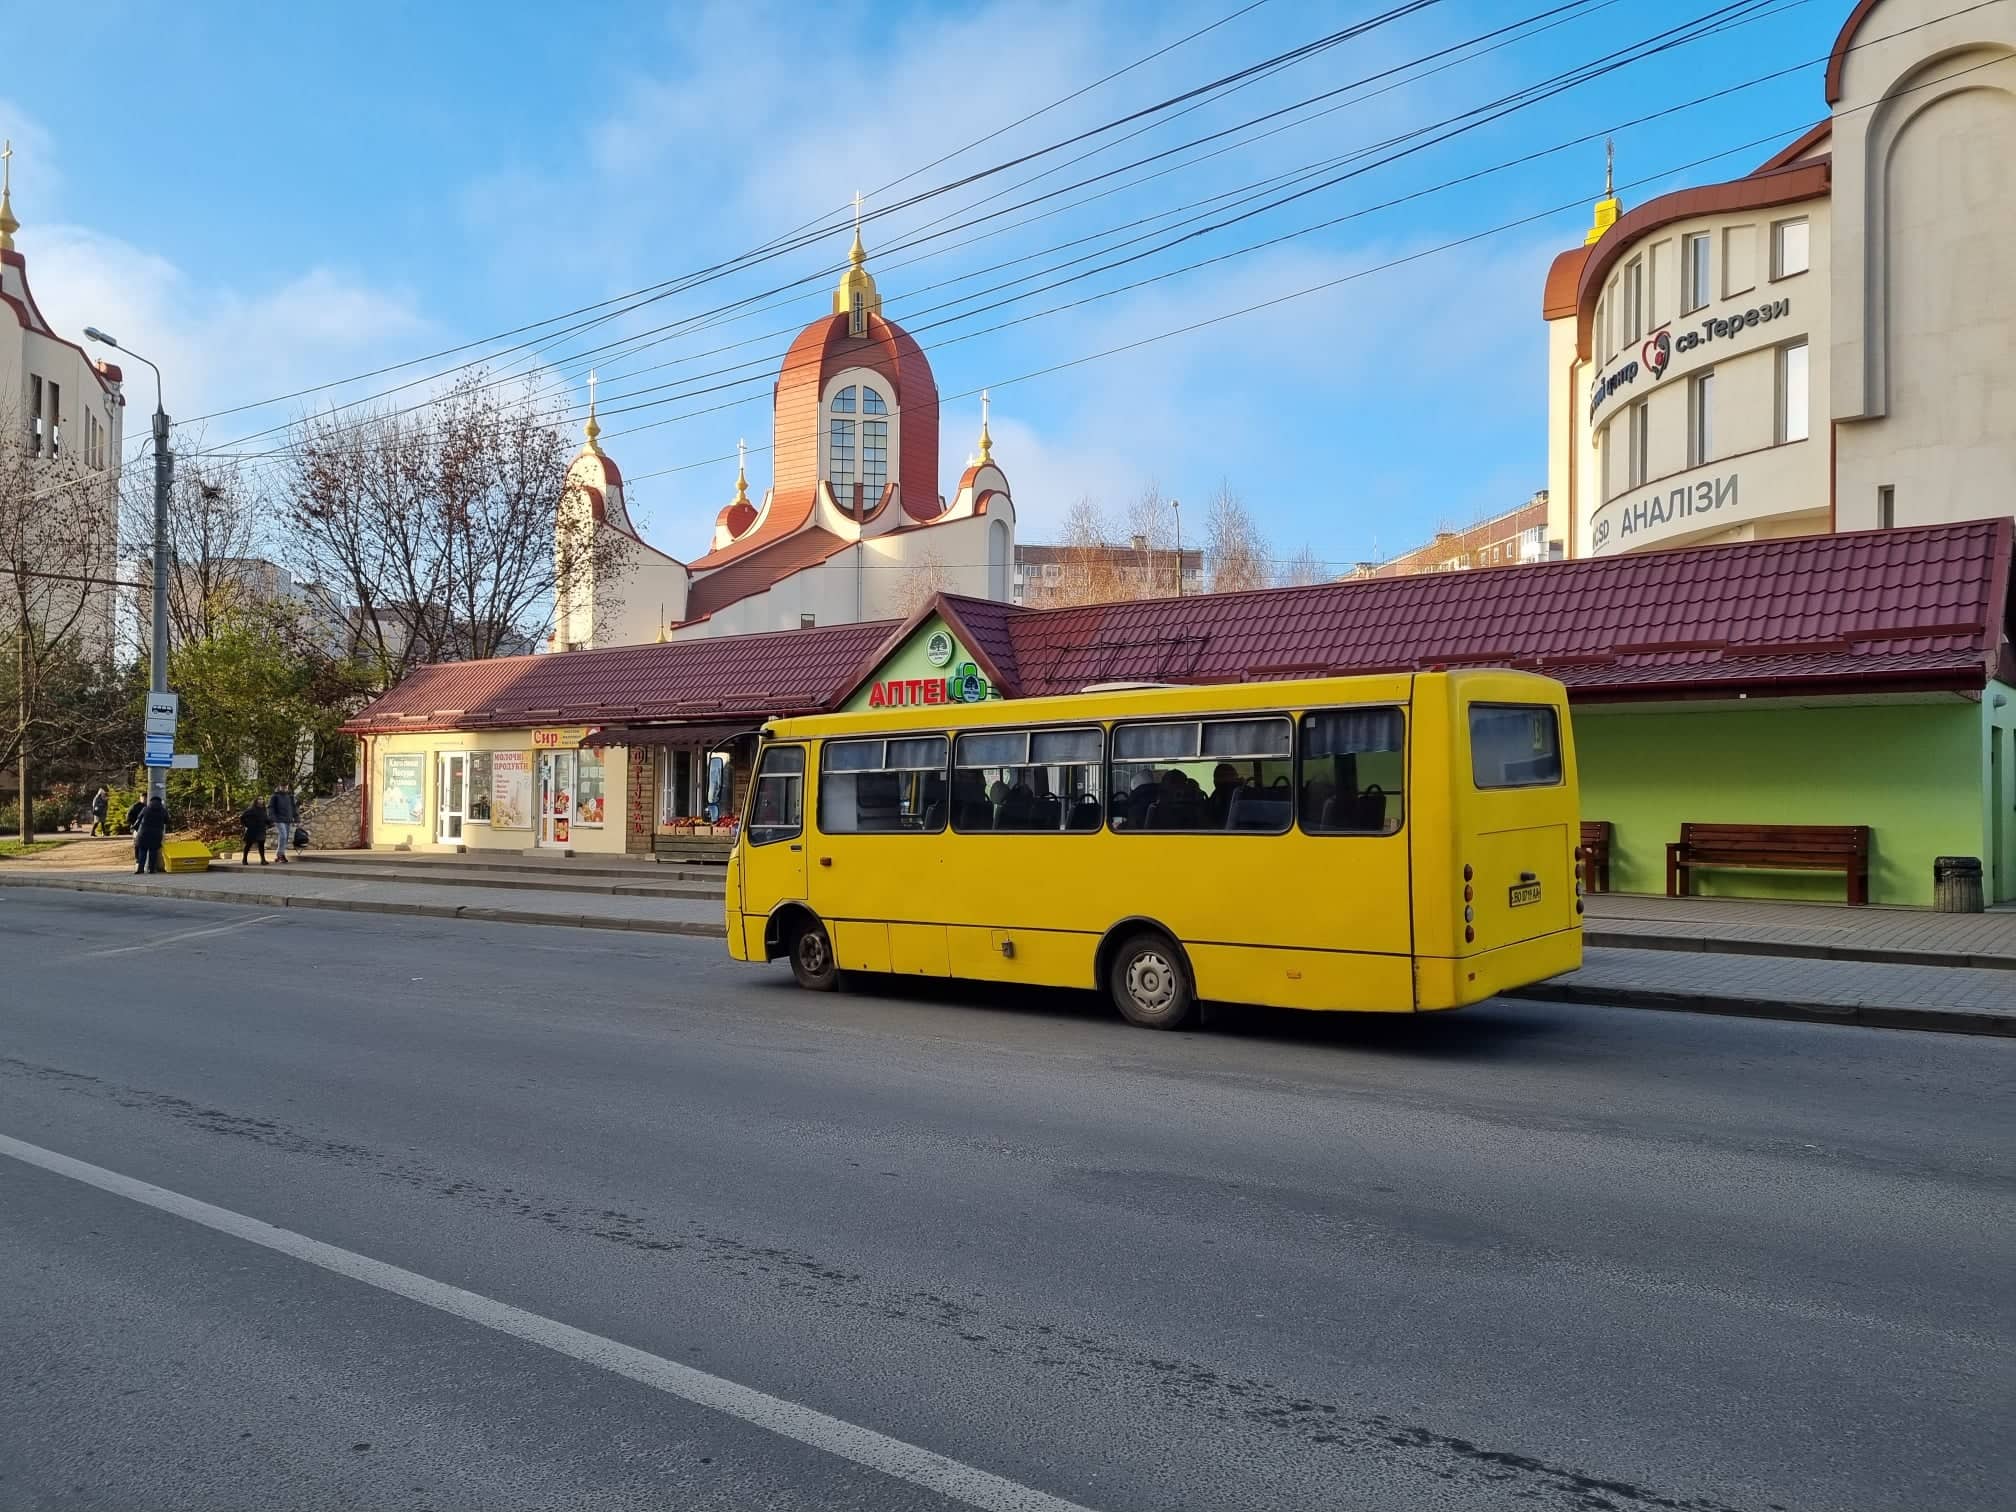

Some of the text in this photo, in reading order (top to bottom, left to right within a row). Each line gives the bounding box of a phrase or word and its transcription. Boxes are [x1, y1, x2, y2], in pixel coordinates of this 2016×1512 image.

[1621, 474, 1738, 539] АНАЛІЗИ
[534, 730, 558, 747] Сир
[494, 762, 529, 770] ПРОДУКТИ
